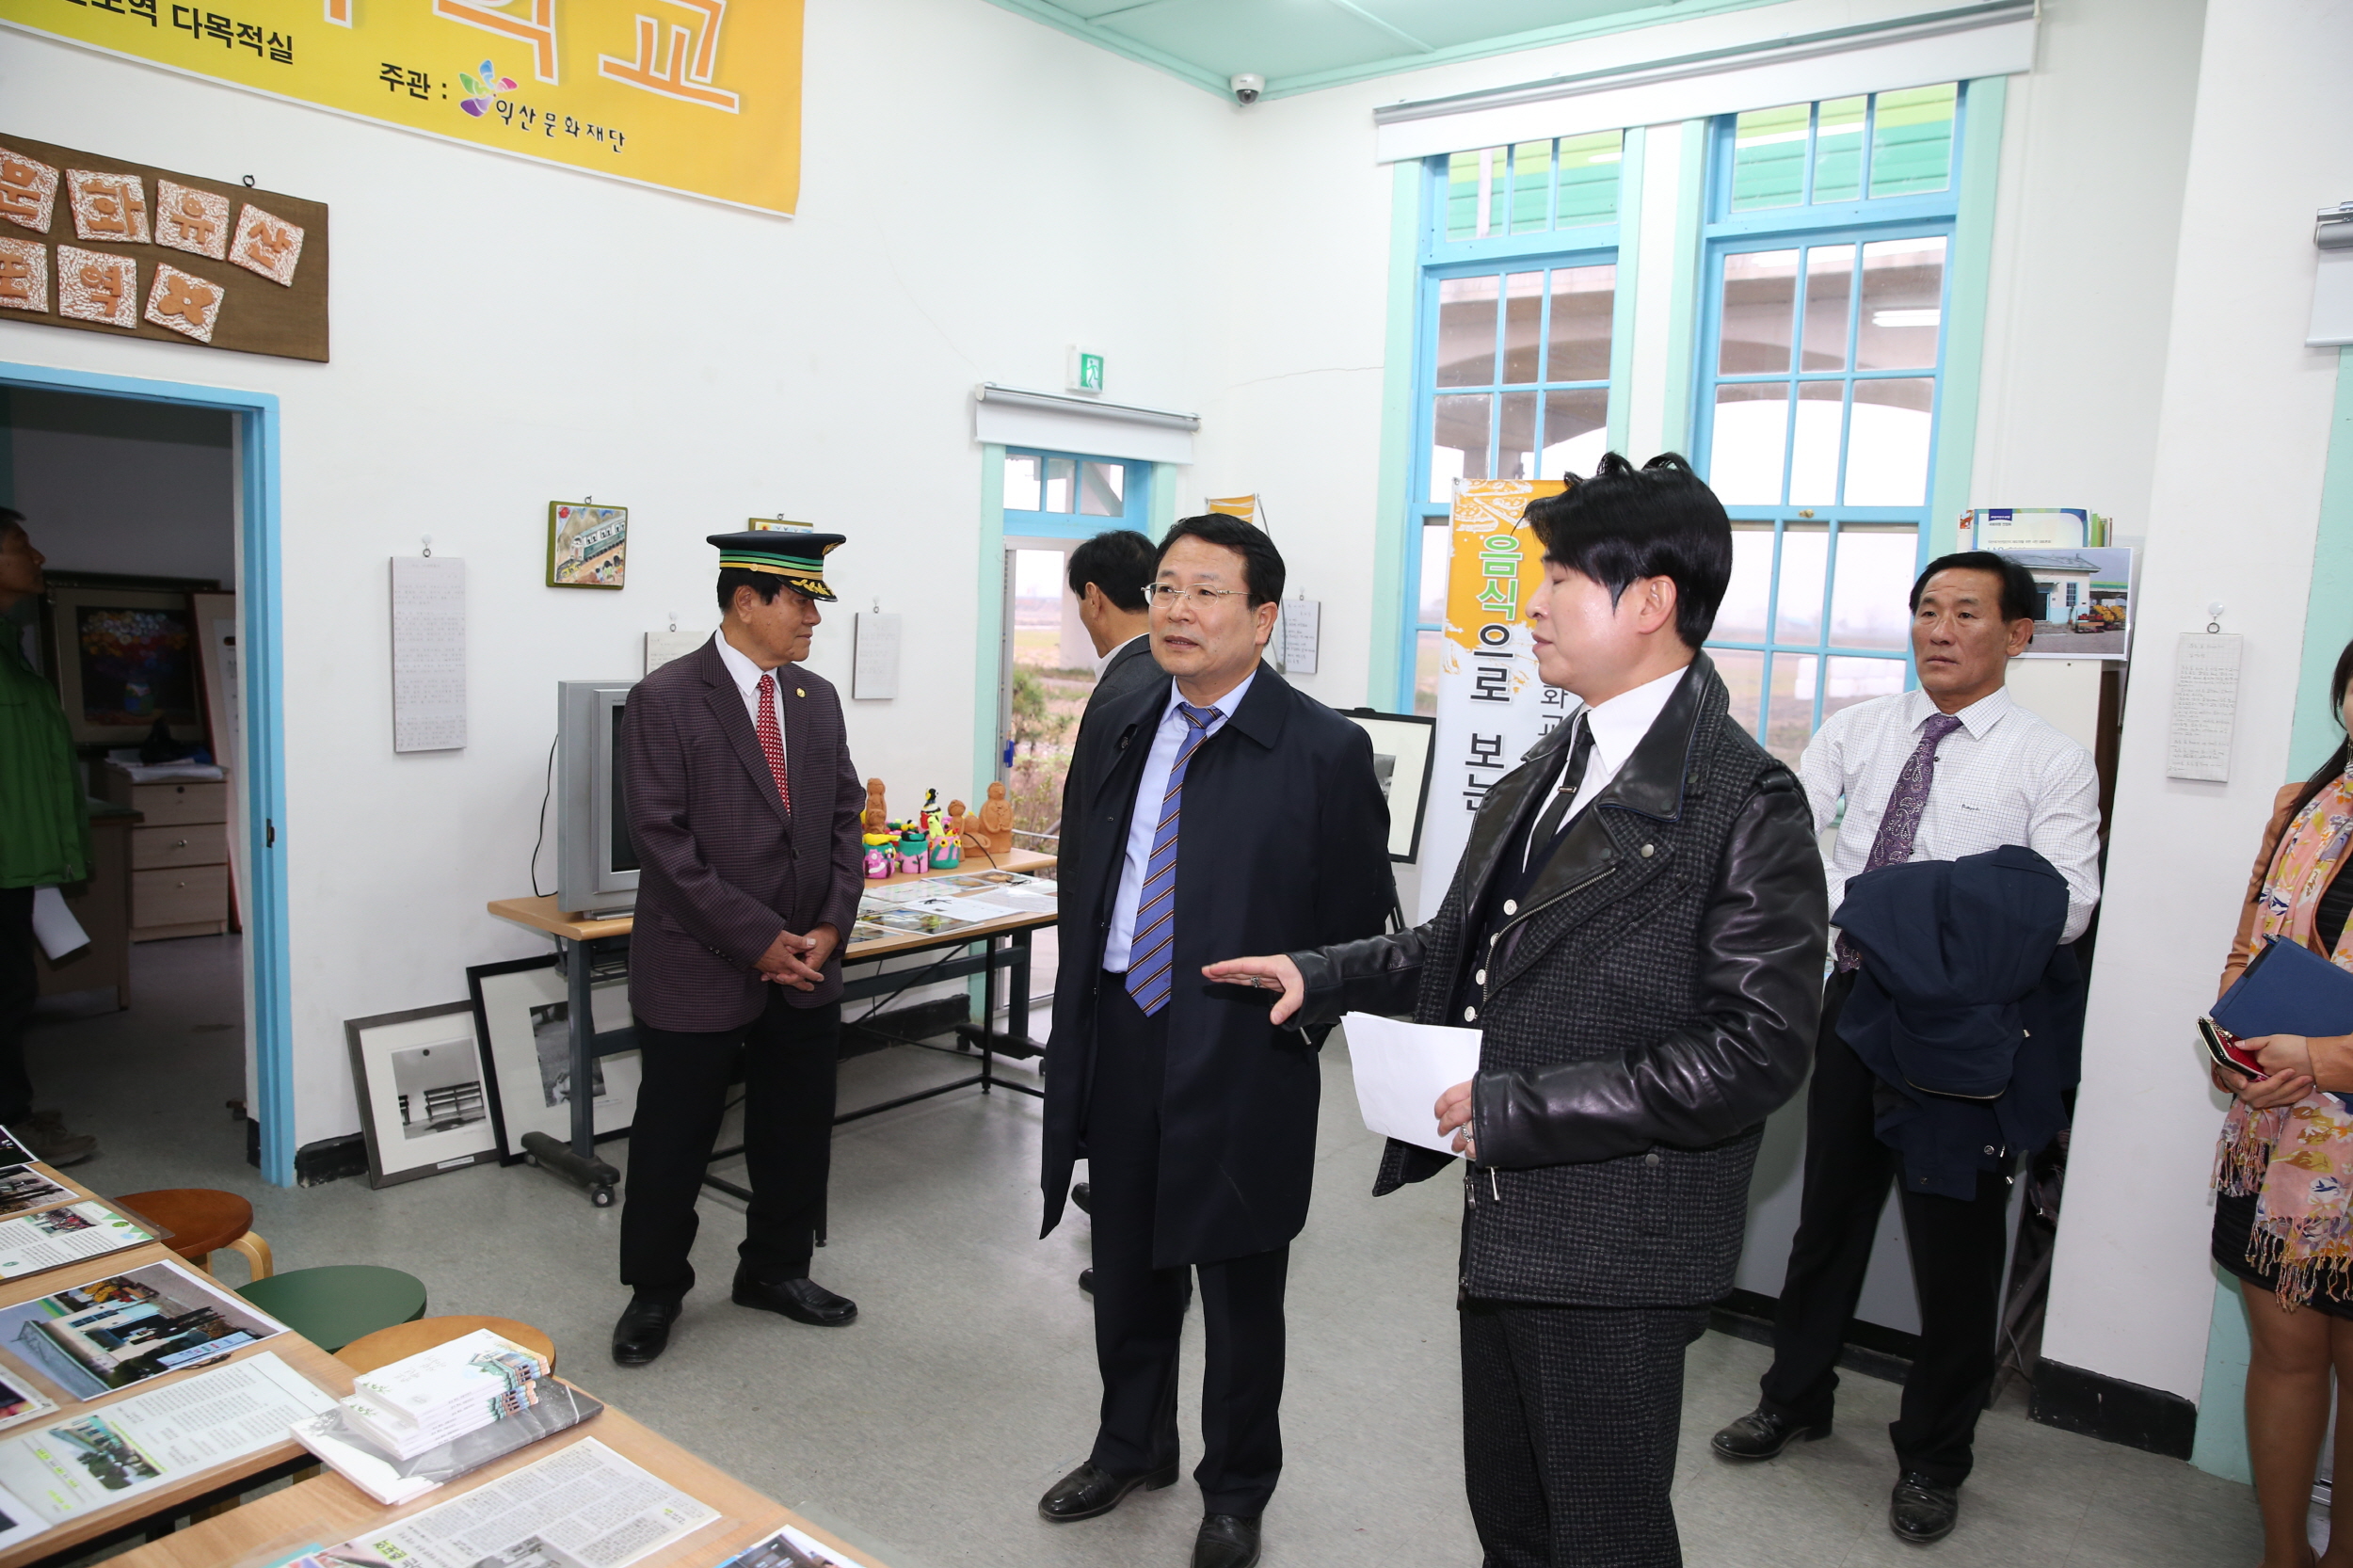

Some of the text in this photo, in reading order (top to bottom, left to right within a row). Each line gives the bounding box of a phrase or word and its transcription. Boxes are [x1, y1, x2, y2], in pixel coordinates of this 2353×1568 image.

[172, 4, 294, 65] 다목적실
[378, 62, 430, 101] 주관
[496, 100, 626, 153] 익산문화재단
[1470, 535, 1524, 703] 음식으로
